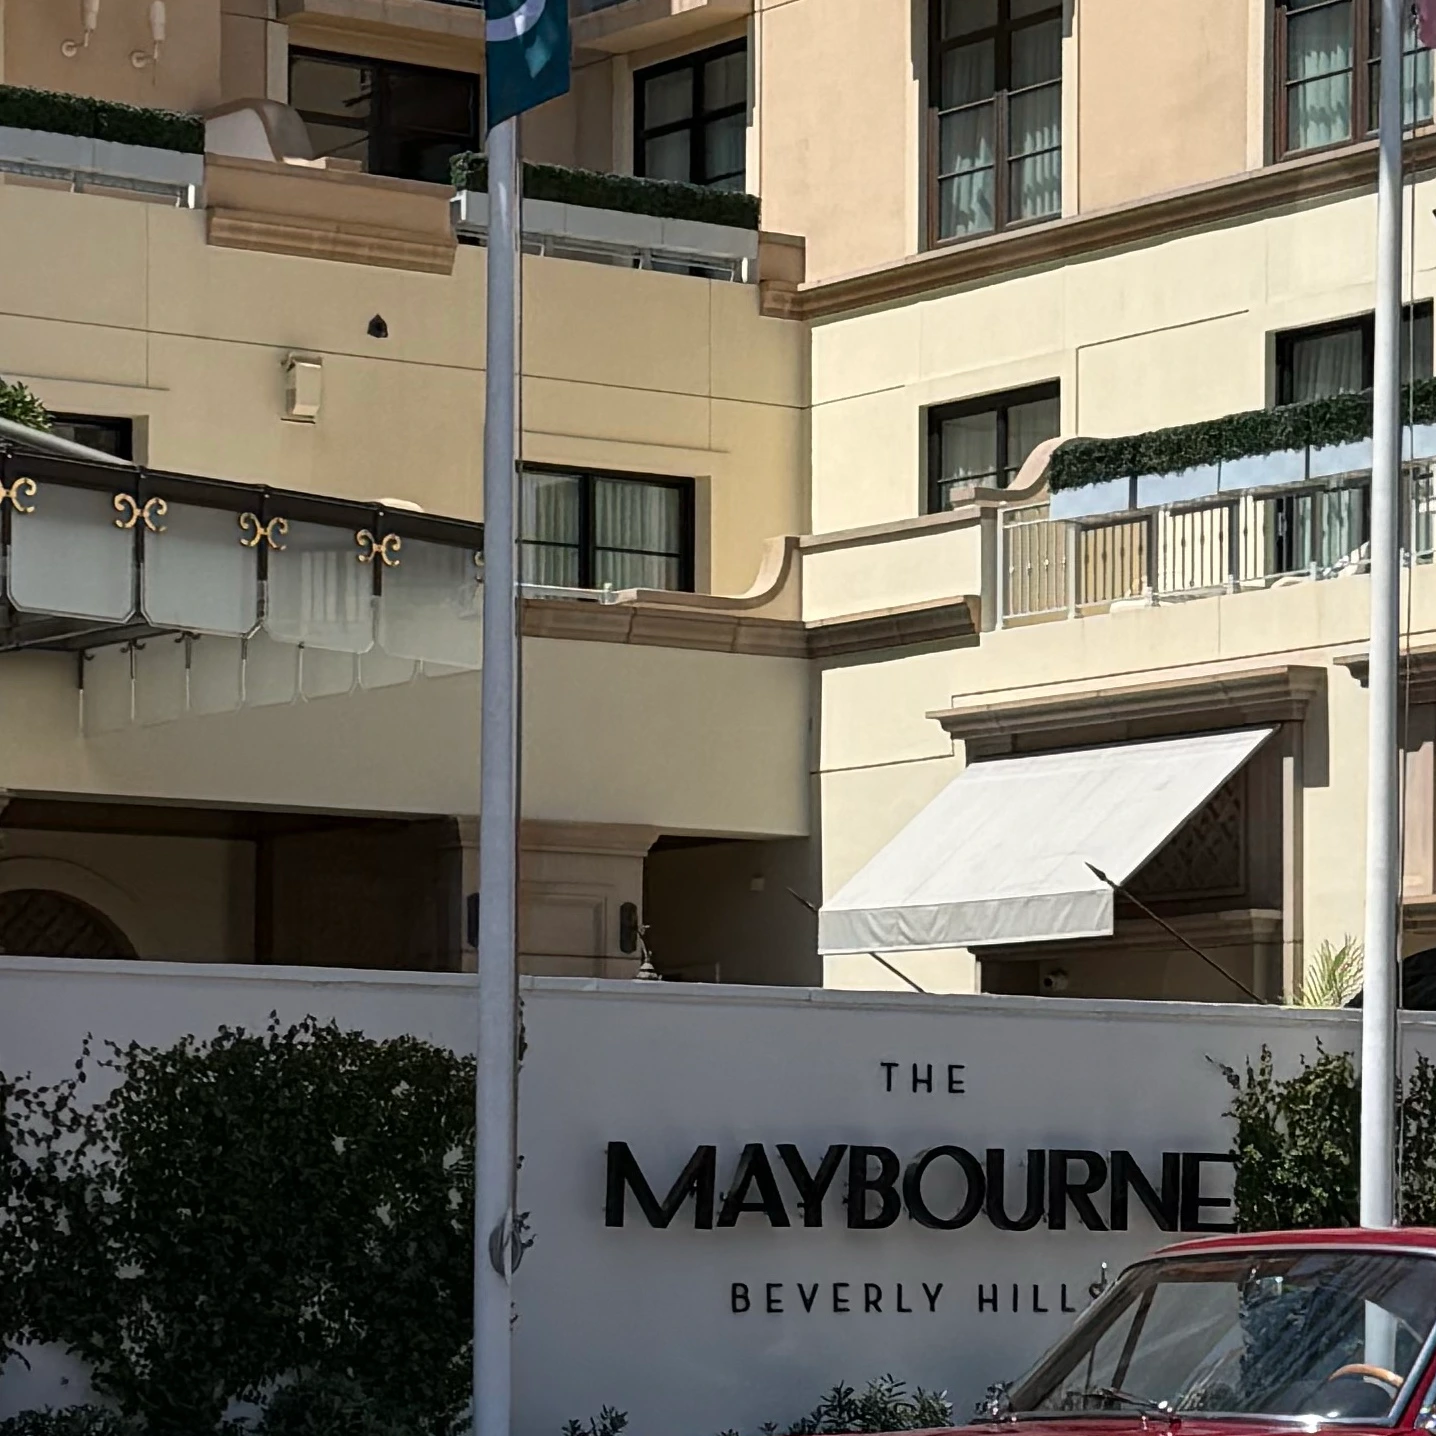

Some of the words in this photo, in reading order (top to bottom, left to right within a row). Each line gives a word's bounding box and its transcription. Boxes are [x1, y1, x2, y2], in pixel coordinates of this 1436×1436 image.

[880, 1061, 967, 1094] THE
[603, 1141, 1239, 1233] MAYBOURNE
[730, 1282, 944, 1314] BEVERLY
